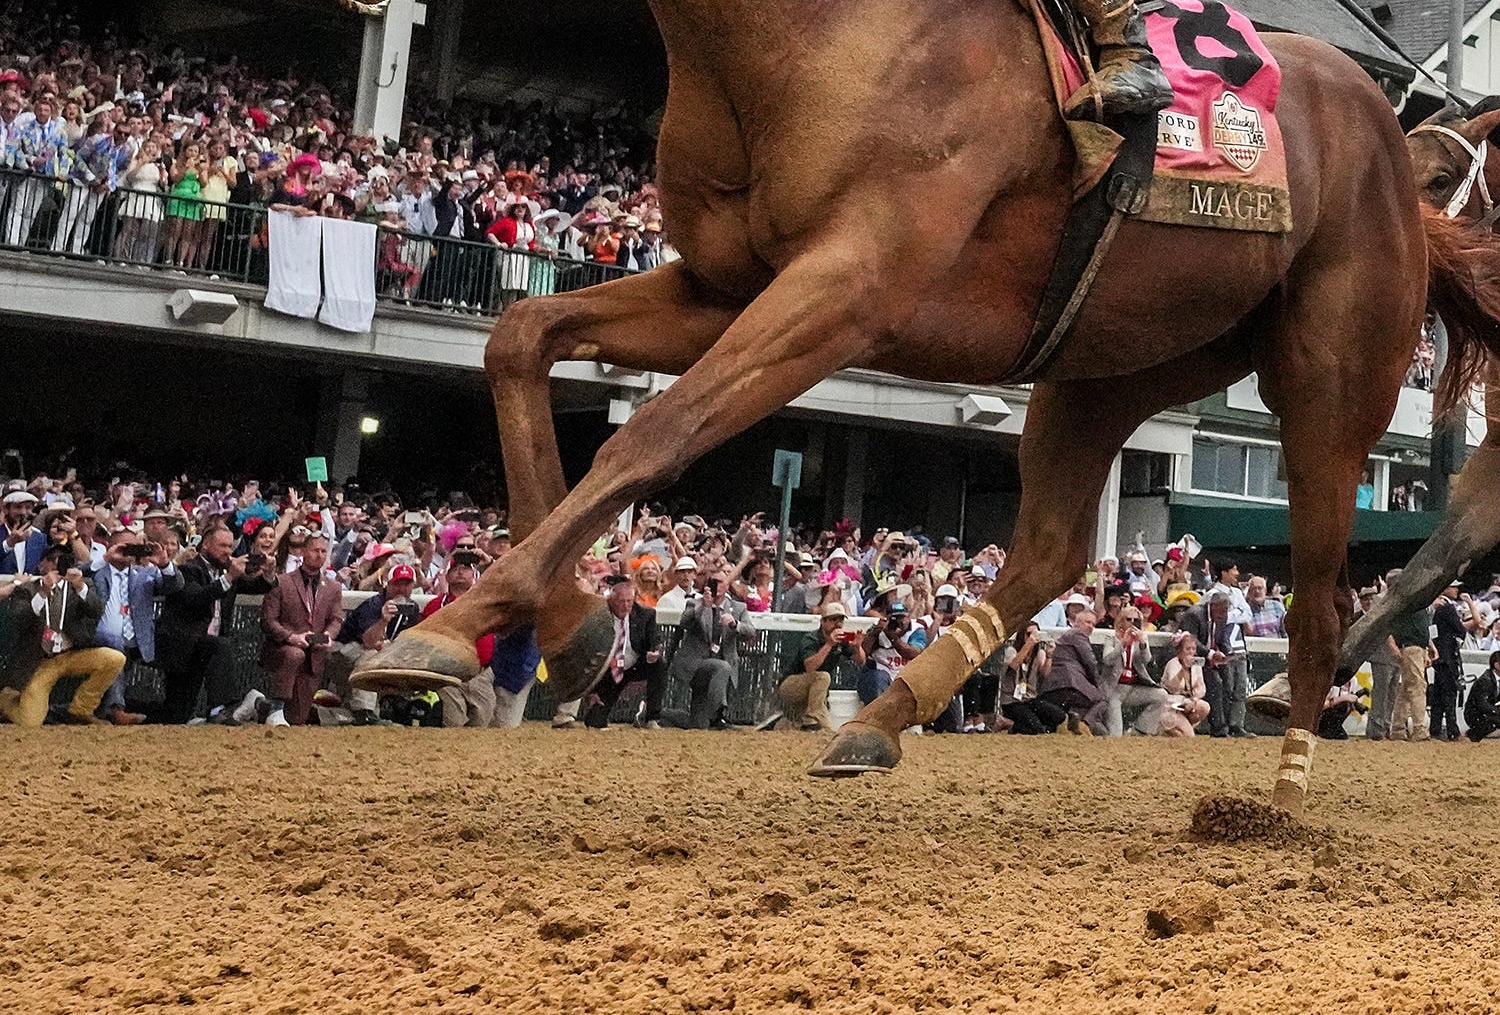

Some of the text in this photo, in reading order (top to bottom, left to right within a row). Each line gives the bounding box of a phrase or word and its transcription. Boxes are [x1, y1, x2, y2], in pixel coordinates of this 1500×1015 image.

[1217, 111, 1256, 134] Kentucky
[1214, 129, 1264, 145] DERBY 149
[1188, 184, 1273, 221] MAGE
